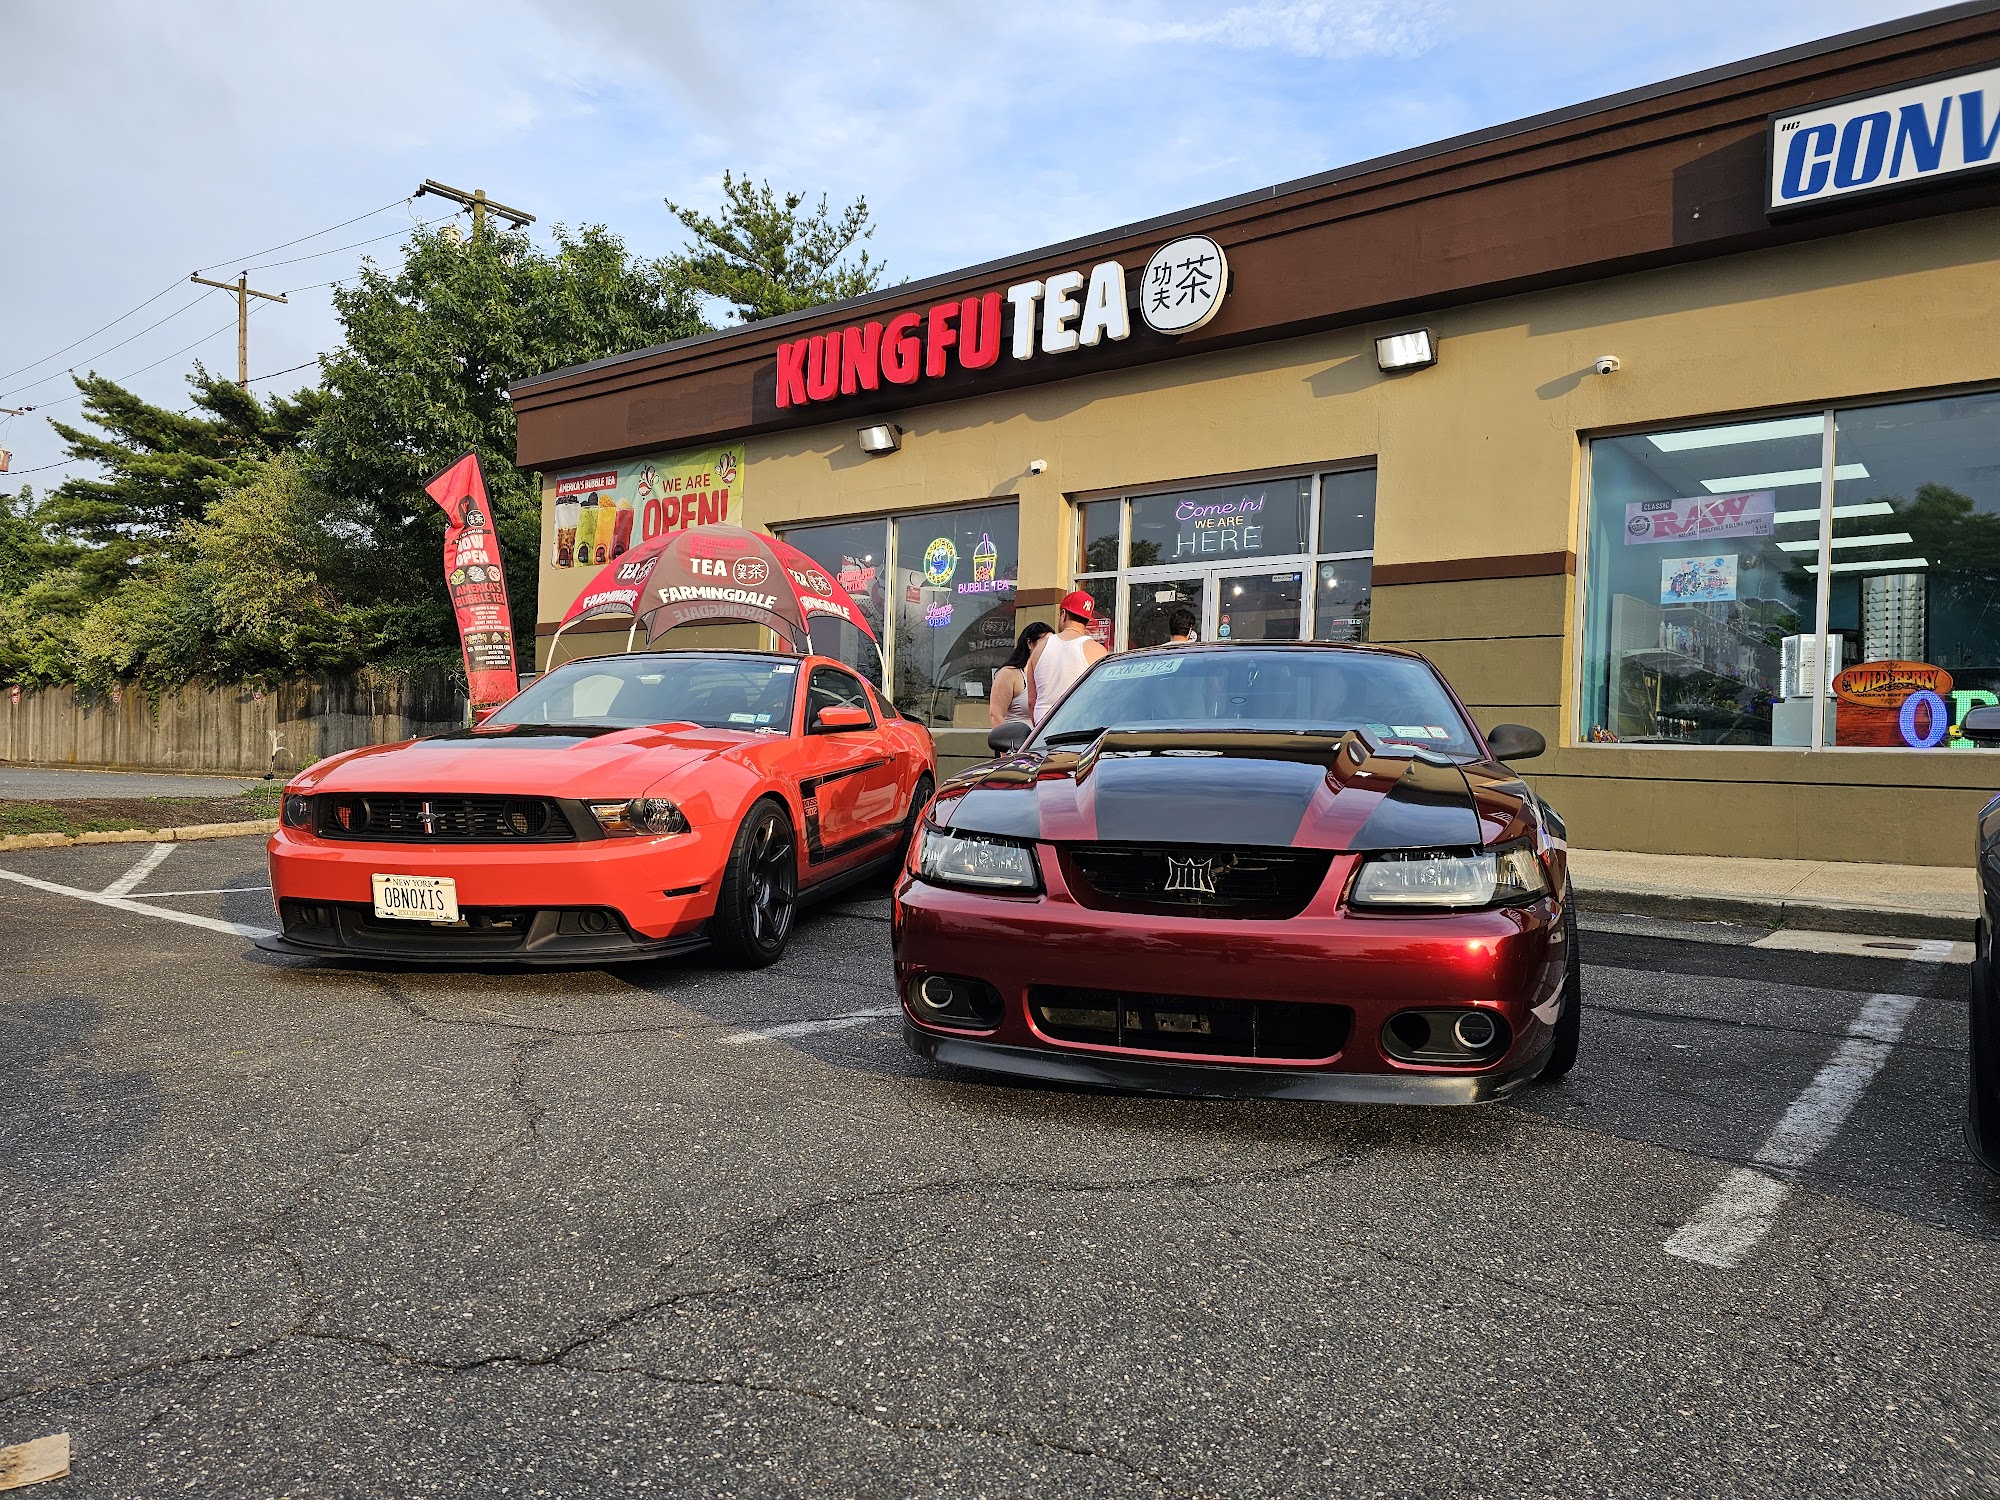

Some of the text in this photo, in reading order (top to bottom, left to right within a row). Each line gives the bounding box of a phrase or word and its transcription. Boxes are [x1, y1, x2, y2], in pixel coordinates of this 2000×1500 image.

[1781, 121, 1800, 132] HC
[1781, 90, 2000, 200] CONV
[1007, 260, 1130, 361] TEA
[558, 475, 615, 494] AMERICA'S BUBBLE TEA
[662, 473, 711, 492] WE ARE
[1175, 501, 1236, 520] Come
[1643, 501, 1671, 511] CLASSIC
[1194, 515, 1244, 528] WE ARE
[1651, 495, 1750, 538] RAW
[1725, 521, 1744, 529] ROLLING
[690, 534, 747, 549] KUNG
[1177, 526, 1261, 554] HERE
[455, 549, 489, 567] OPEN
[690, 546, 715, 558] FU
[617, 563, 641, 579] TEA
[690, 558, 727, 577] TEA
[456, 583, 501, 596] AMERICA'S
[958, 580, 1009, 593] BUBBLE TEA
[455, 593, 491, 607] BUBBLE
[658, 586, 777, 609] FARMINGDALE
[925, 602, 954, 620] Lounge
[929, 615, 951, 627] OPEN
[1107, 664, 1134, 676] KXN
[1843, 670, 1939, 693] WILD BERRY
[805, 806, 818, 817] 302
[392, 878, 434, 888] NEW YORK
[384, 887, 444, 910] OBNOXIS
